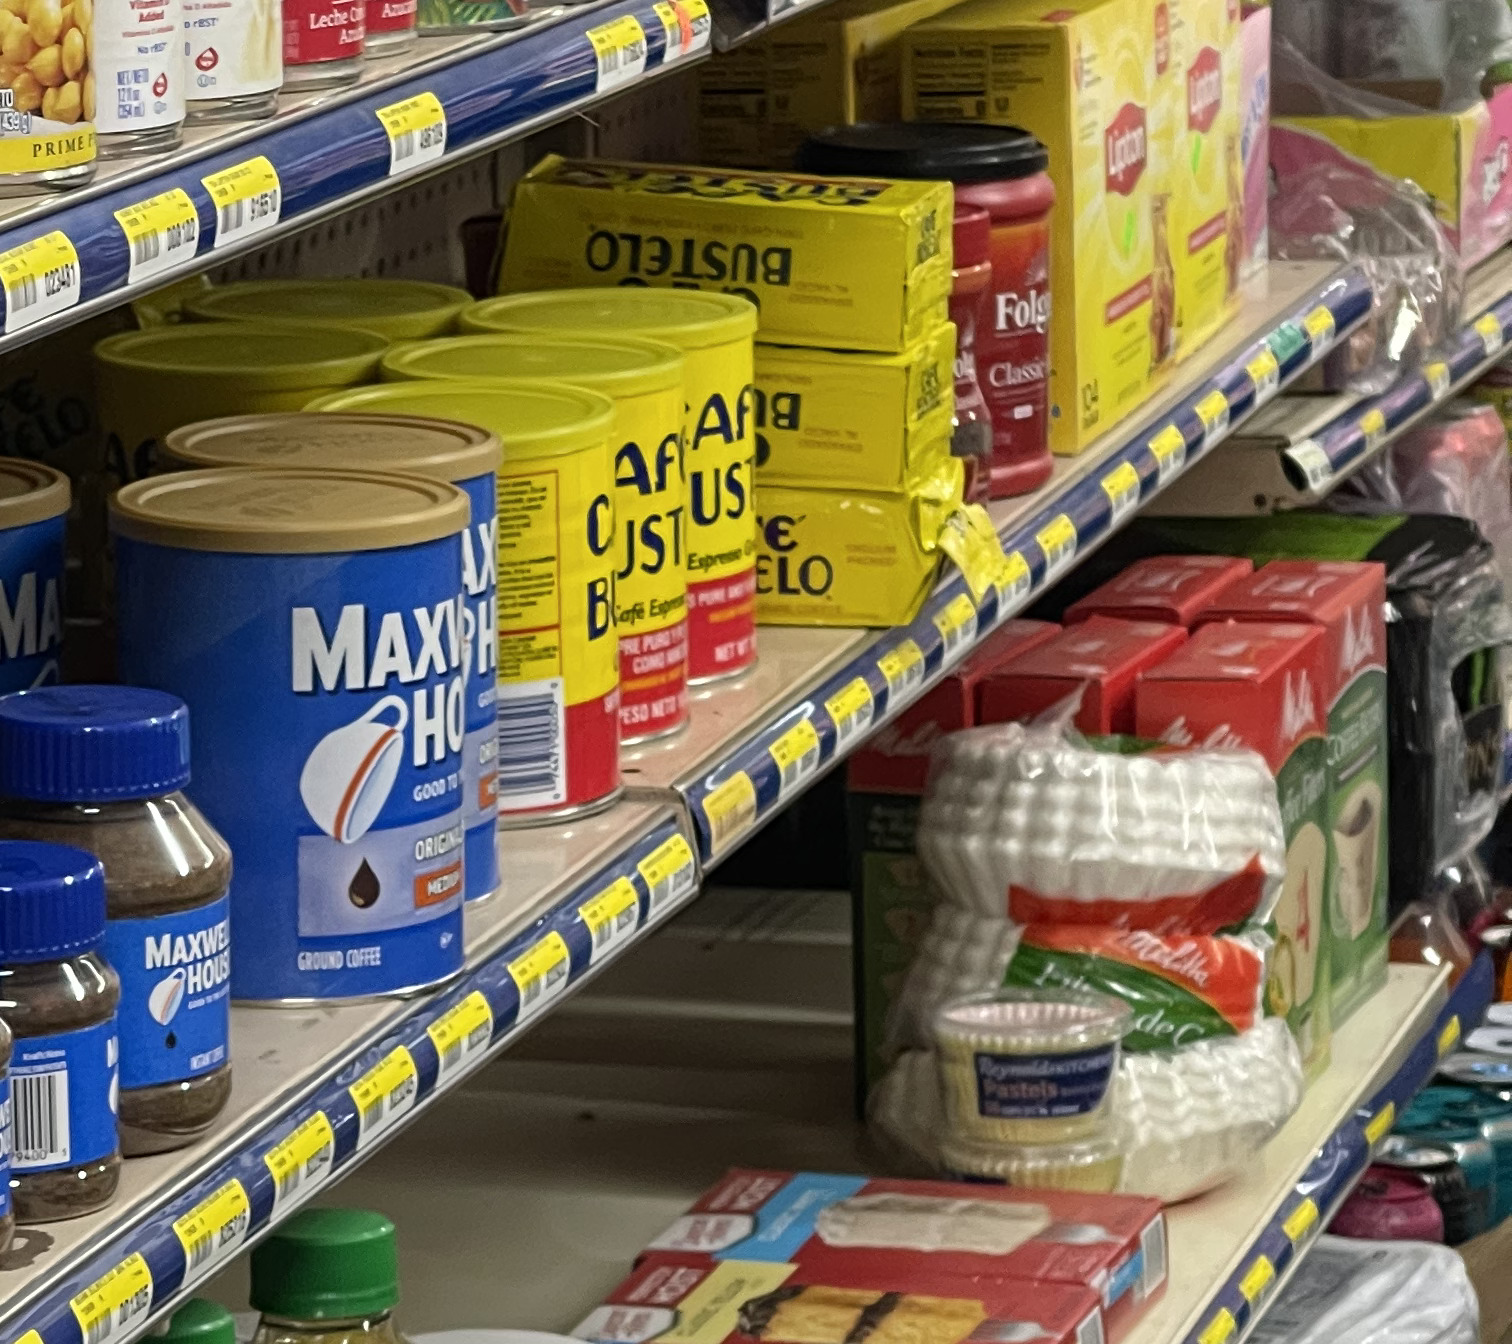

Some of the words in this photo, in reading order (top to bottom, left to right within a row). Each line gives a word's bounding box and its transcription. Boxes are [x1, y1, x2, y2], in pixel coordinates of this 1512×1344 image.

[33, 135, 86, 158] PRIME
[298, 949, 343, 970] GROUND
[345, 947, 381, 967] COFFEE
